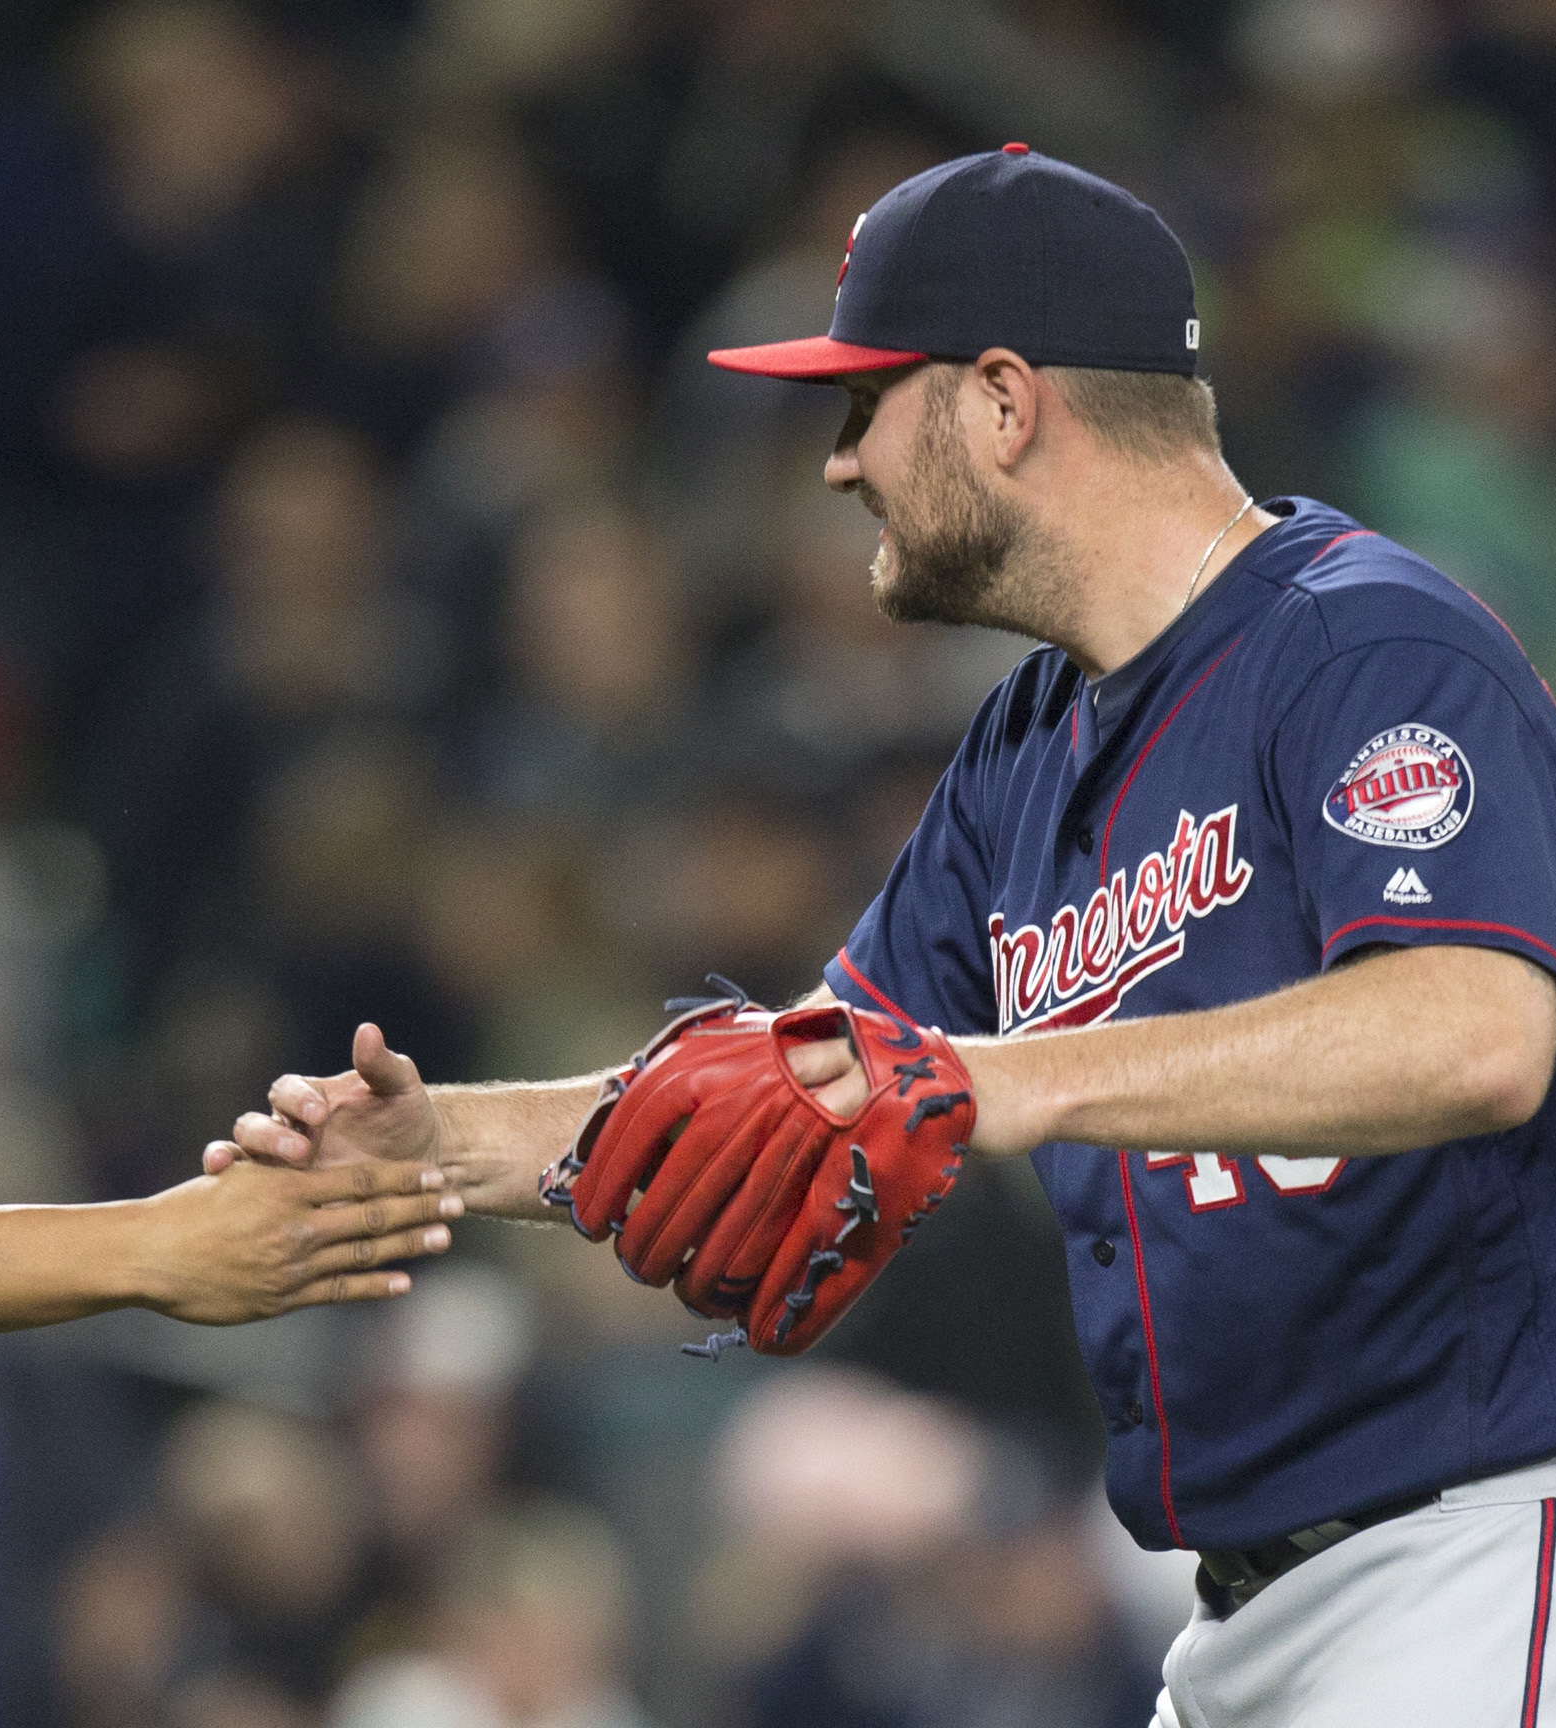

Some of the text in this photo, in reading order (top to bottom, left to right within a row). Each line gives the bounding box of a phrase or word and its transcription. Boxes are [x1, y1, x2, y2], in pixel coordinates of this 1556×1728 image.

[1339, 728, 1455, 784] MINNESOTA
[1331, 757, 1462, 815] Twins
[1344, 808, 1463, 844] BASEBALL CLUB
